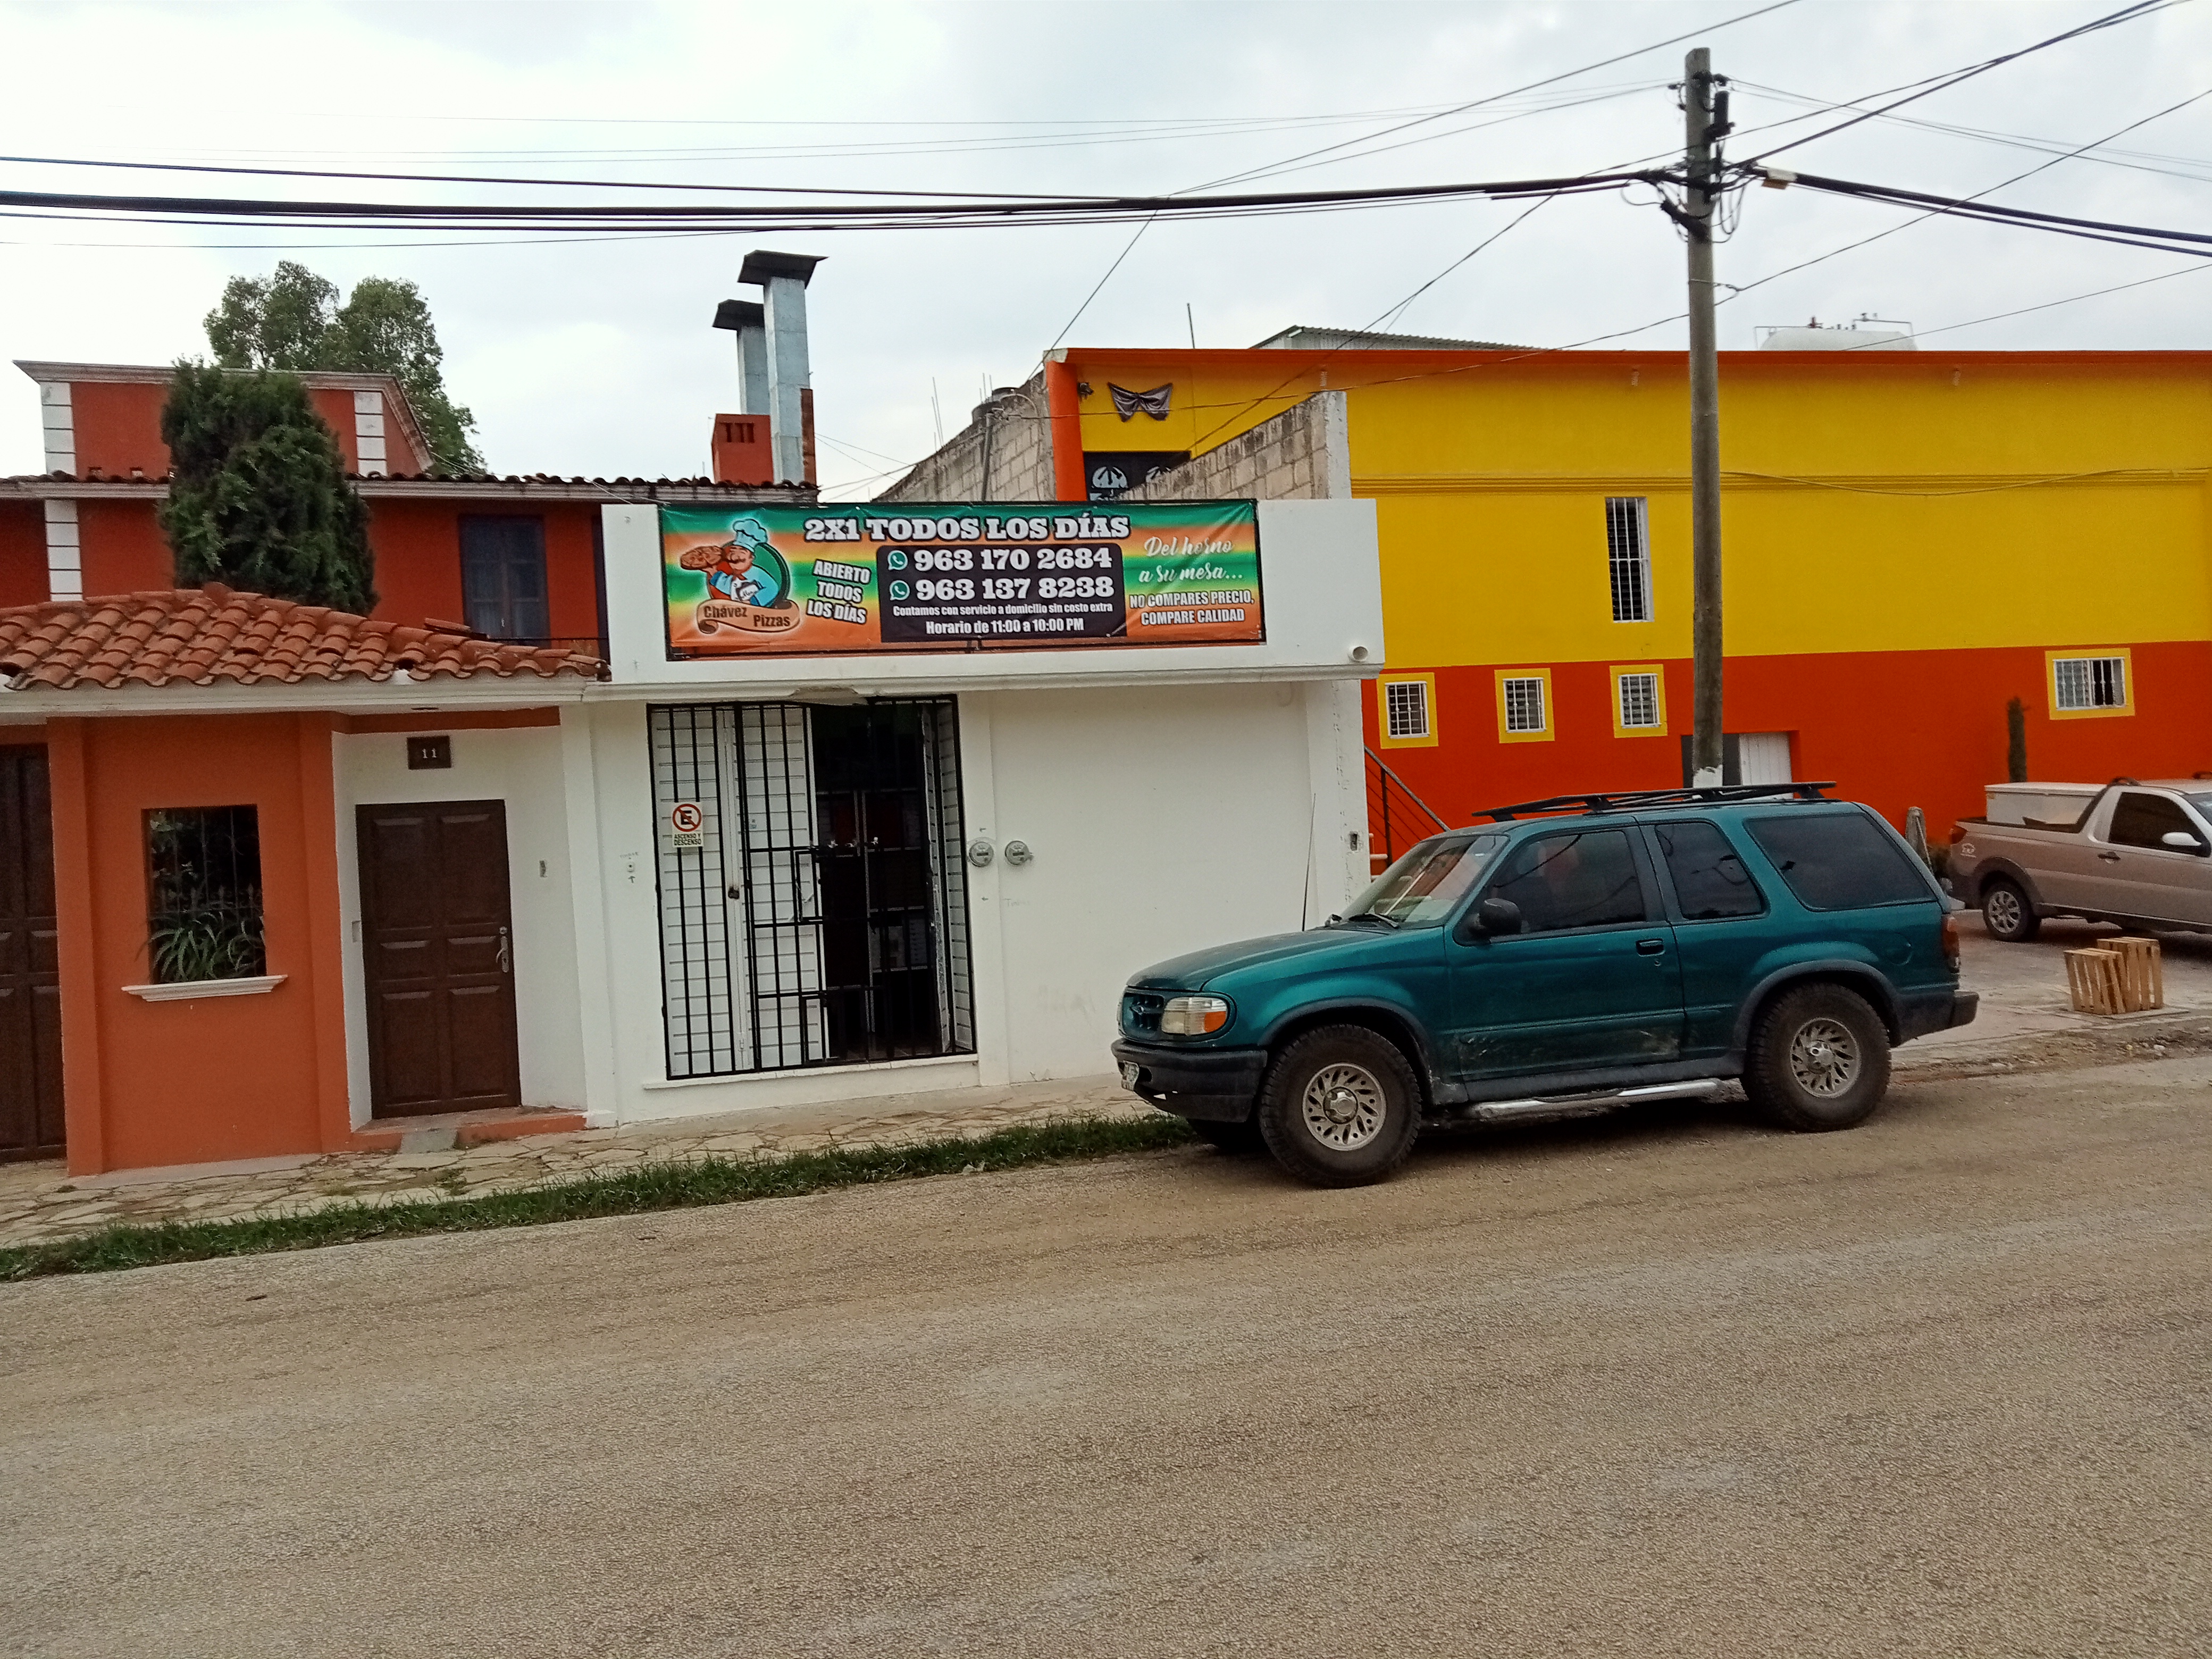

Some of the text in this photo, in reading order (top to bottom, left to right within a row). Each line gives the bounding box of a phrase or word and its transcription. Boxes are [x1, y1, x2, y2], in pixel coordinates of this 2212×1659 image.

[805, 513, 1130, 541] 2X1 TODOS LOS DÍAS
[1144, 536, 1233, 557] Del horno
[914, 547, 1112, 572] 963 170 2684
[813, 559, 871, 584] ABIERTO
[1138, 569, 1153, 583] a
[817, 581, 863, 603] TODOS
[915, 576, 1115, 601] 963 137 8238
[1129, 594, 1146, 608] NO
[1147, 591, 1209, 607] COMPARES
[703, 605, 748, 618] Chávez
[807, 599, 867, 624] LOS DÍAS
[893, 605, 940, 617] Contamos
[941, 607, 958, 616] con
[959, 605, 997, 615] servicio
[1004, 604, 1048, 615] domicilio
[1049, 603, 1063, 613] sin
[1063, 604, 1089, 613] costo
[1090, 602, 1113, 612] extra
[1141, 608, 1245, 626] COMPARE CALIDAD
[753, 614, 791, 627] Pizzas
[926, 618, 1084, 635] Horario de 11:00 a 10:00 PM
[681, 810, 692, 825] E
